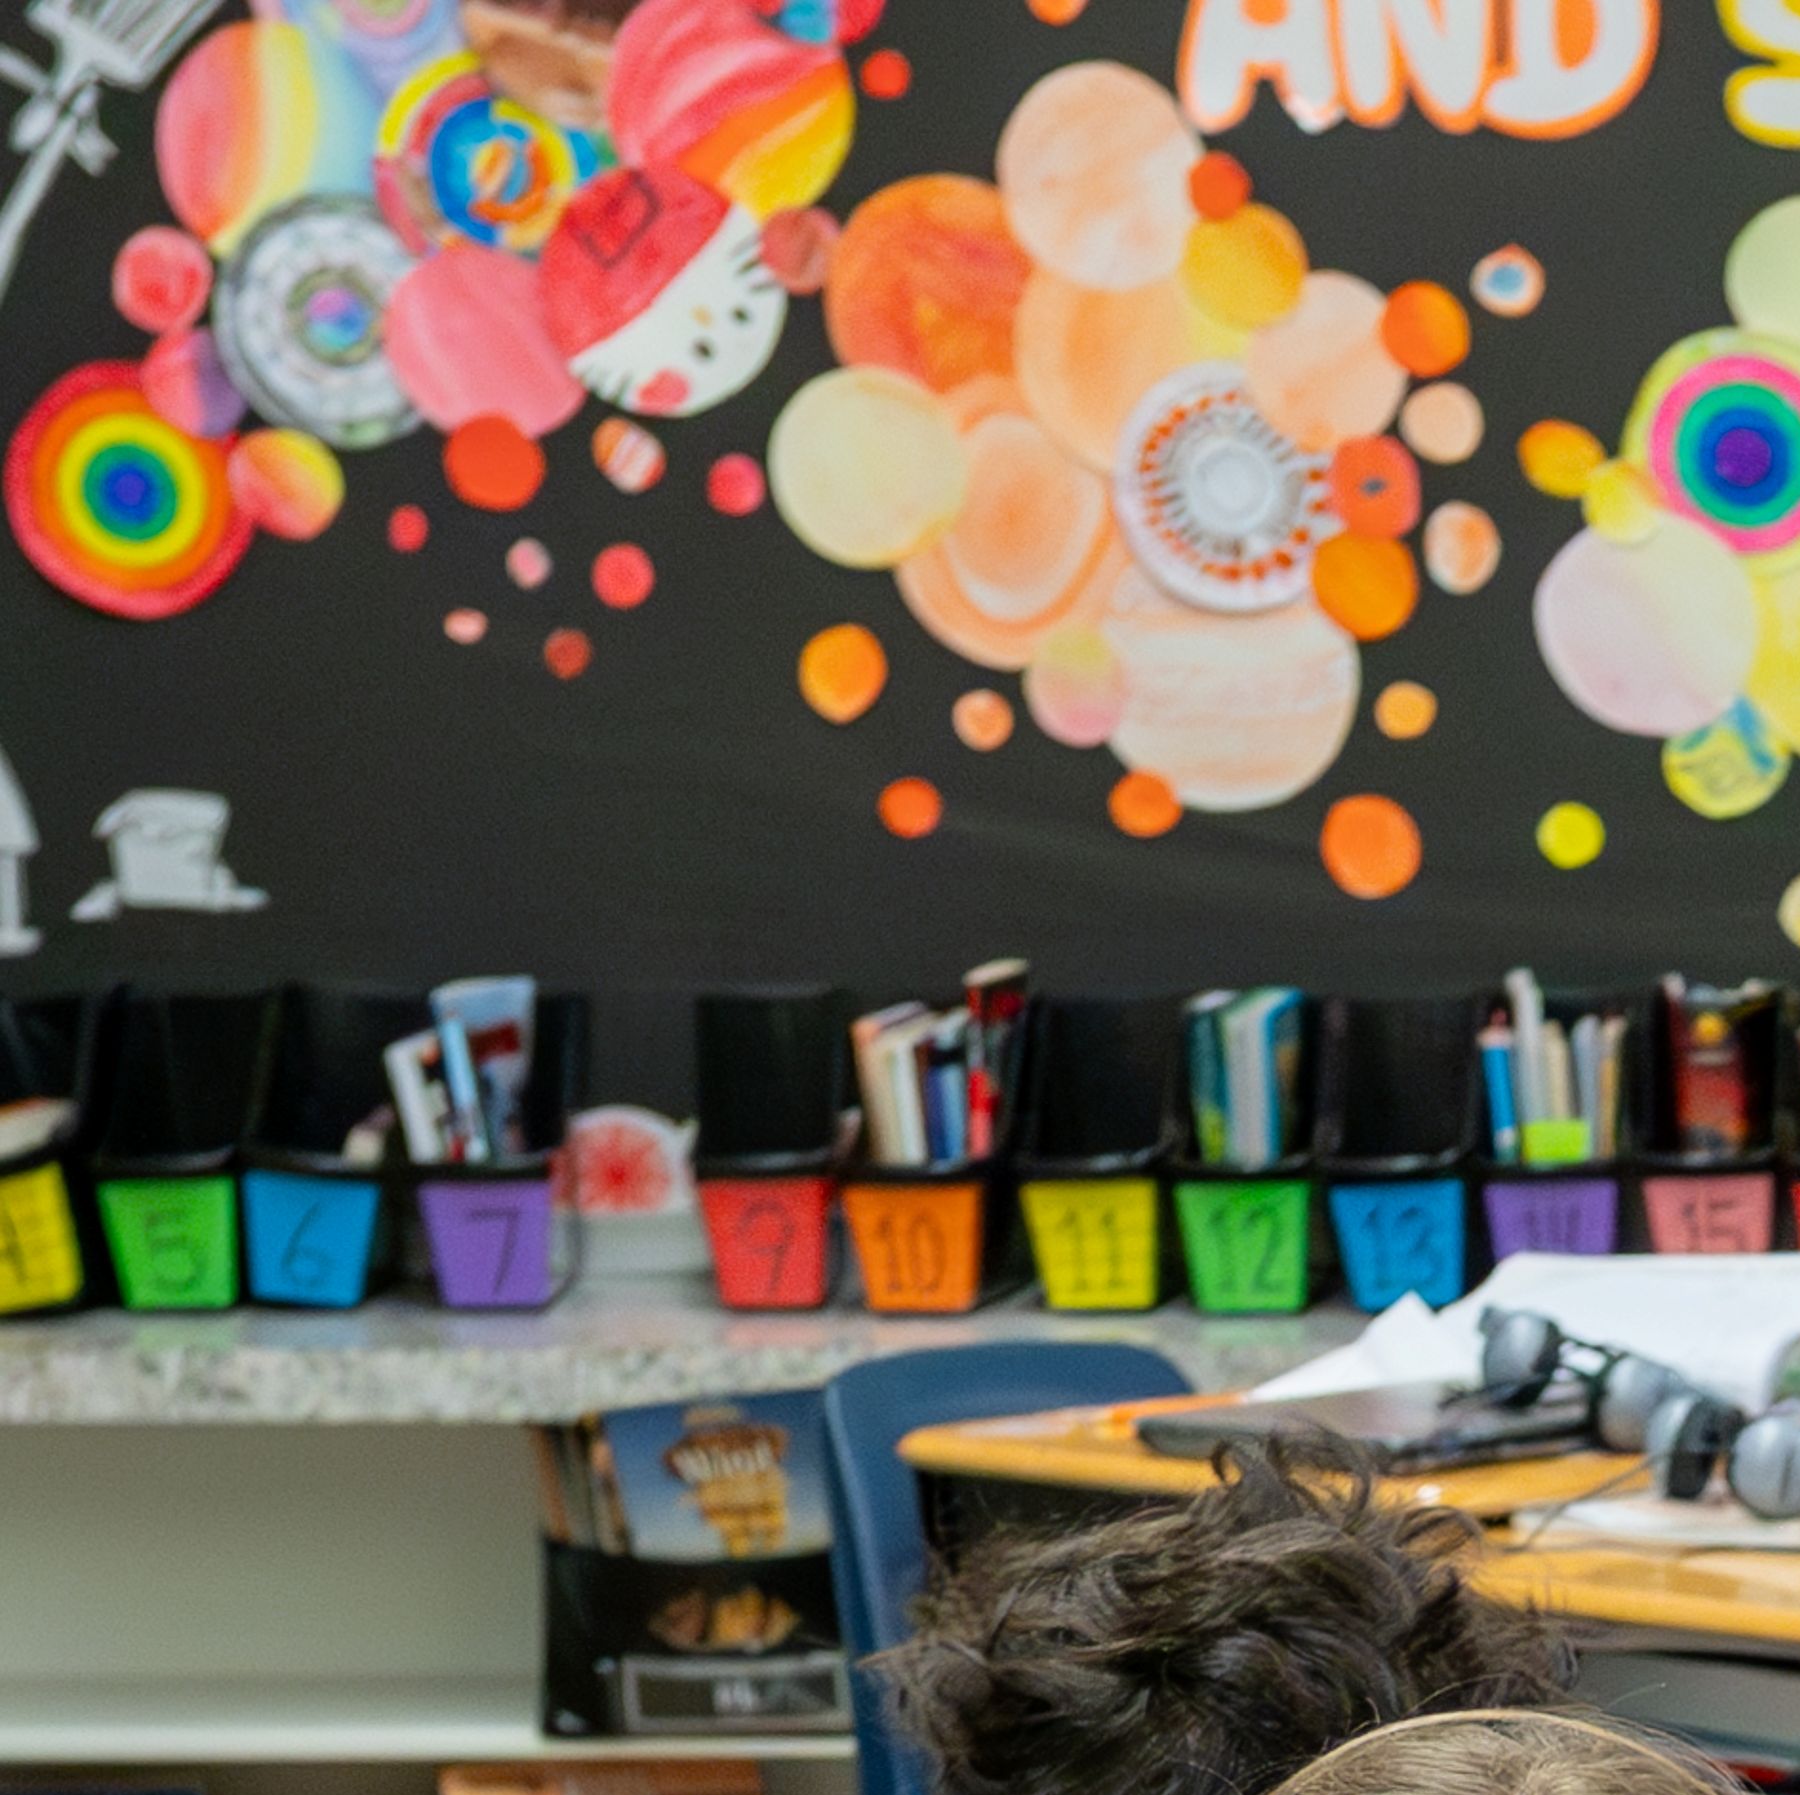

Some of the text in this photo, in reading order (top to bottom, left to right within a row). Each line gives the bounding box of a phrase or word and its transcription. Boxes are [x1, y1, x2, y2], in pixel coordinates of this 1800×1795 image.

[1177, 0, 1660, 141] AND
[143, 1209, 206, 1293] 5
[280, 1202, 332, 1287] 6
[464, 1209, 521, 1294] 7
[737, 1203, 796, 1294] 9
[877, 1209, 946, 1294] 10
[1056, 1207, 1131, 1293] 11
[1209, 1206, 1285, 1295] 12
[1365, 1206, 1435, 1292] 13
